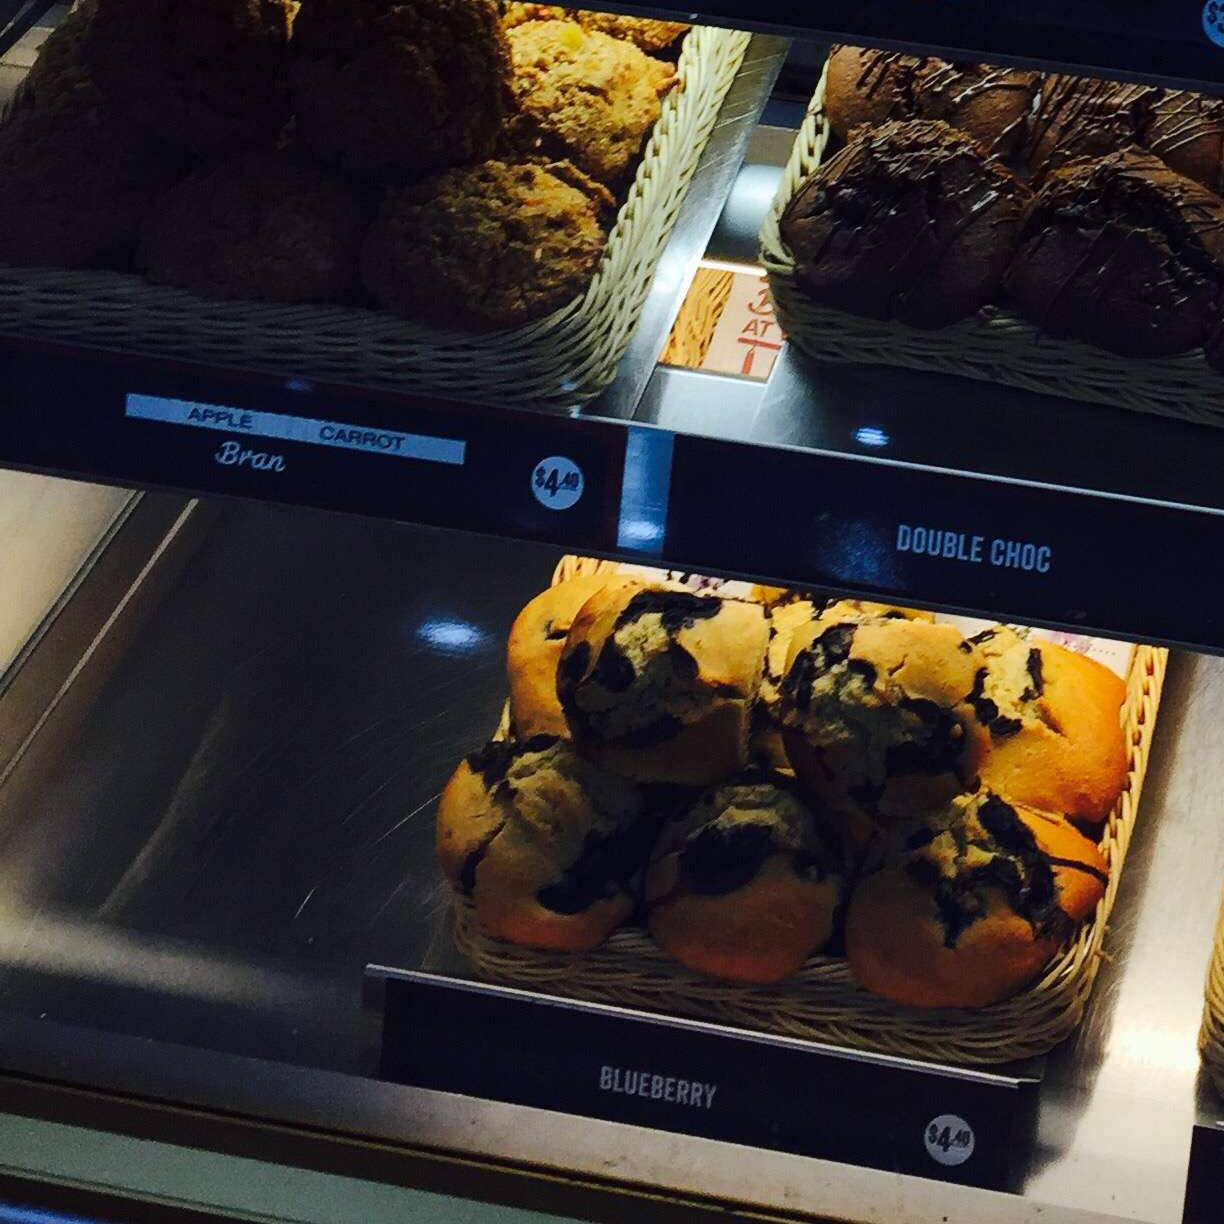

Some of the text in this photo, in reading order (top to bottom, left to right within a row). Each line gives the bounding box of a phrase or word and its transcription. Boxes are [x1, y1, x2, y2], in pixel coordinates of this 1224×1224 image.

[742, 319, 774, 337] AT
[187, 406, 405, 451] APPLE CARROT
[214, 440, 286, 474] Bran
[897, 525, 1053, 573] DOUBLE CHOC
[600, 1065, 717, 1110] BLUEBERRY
